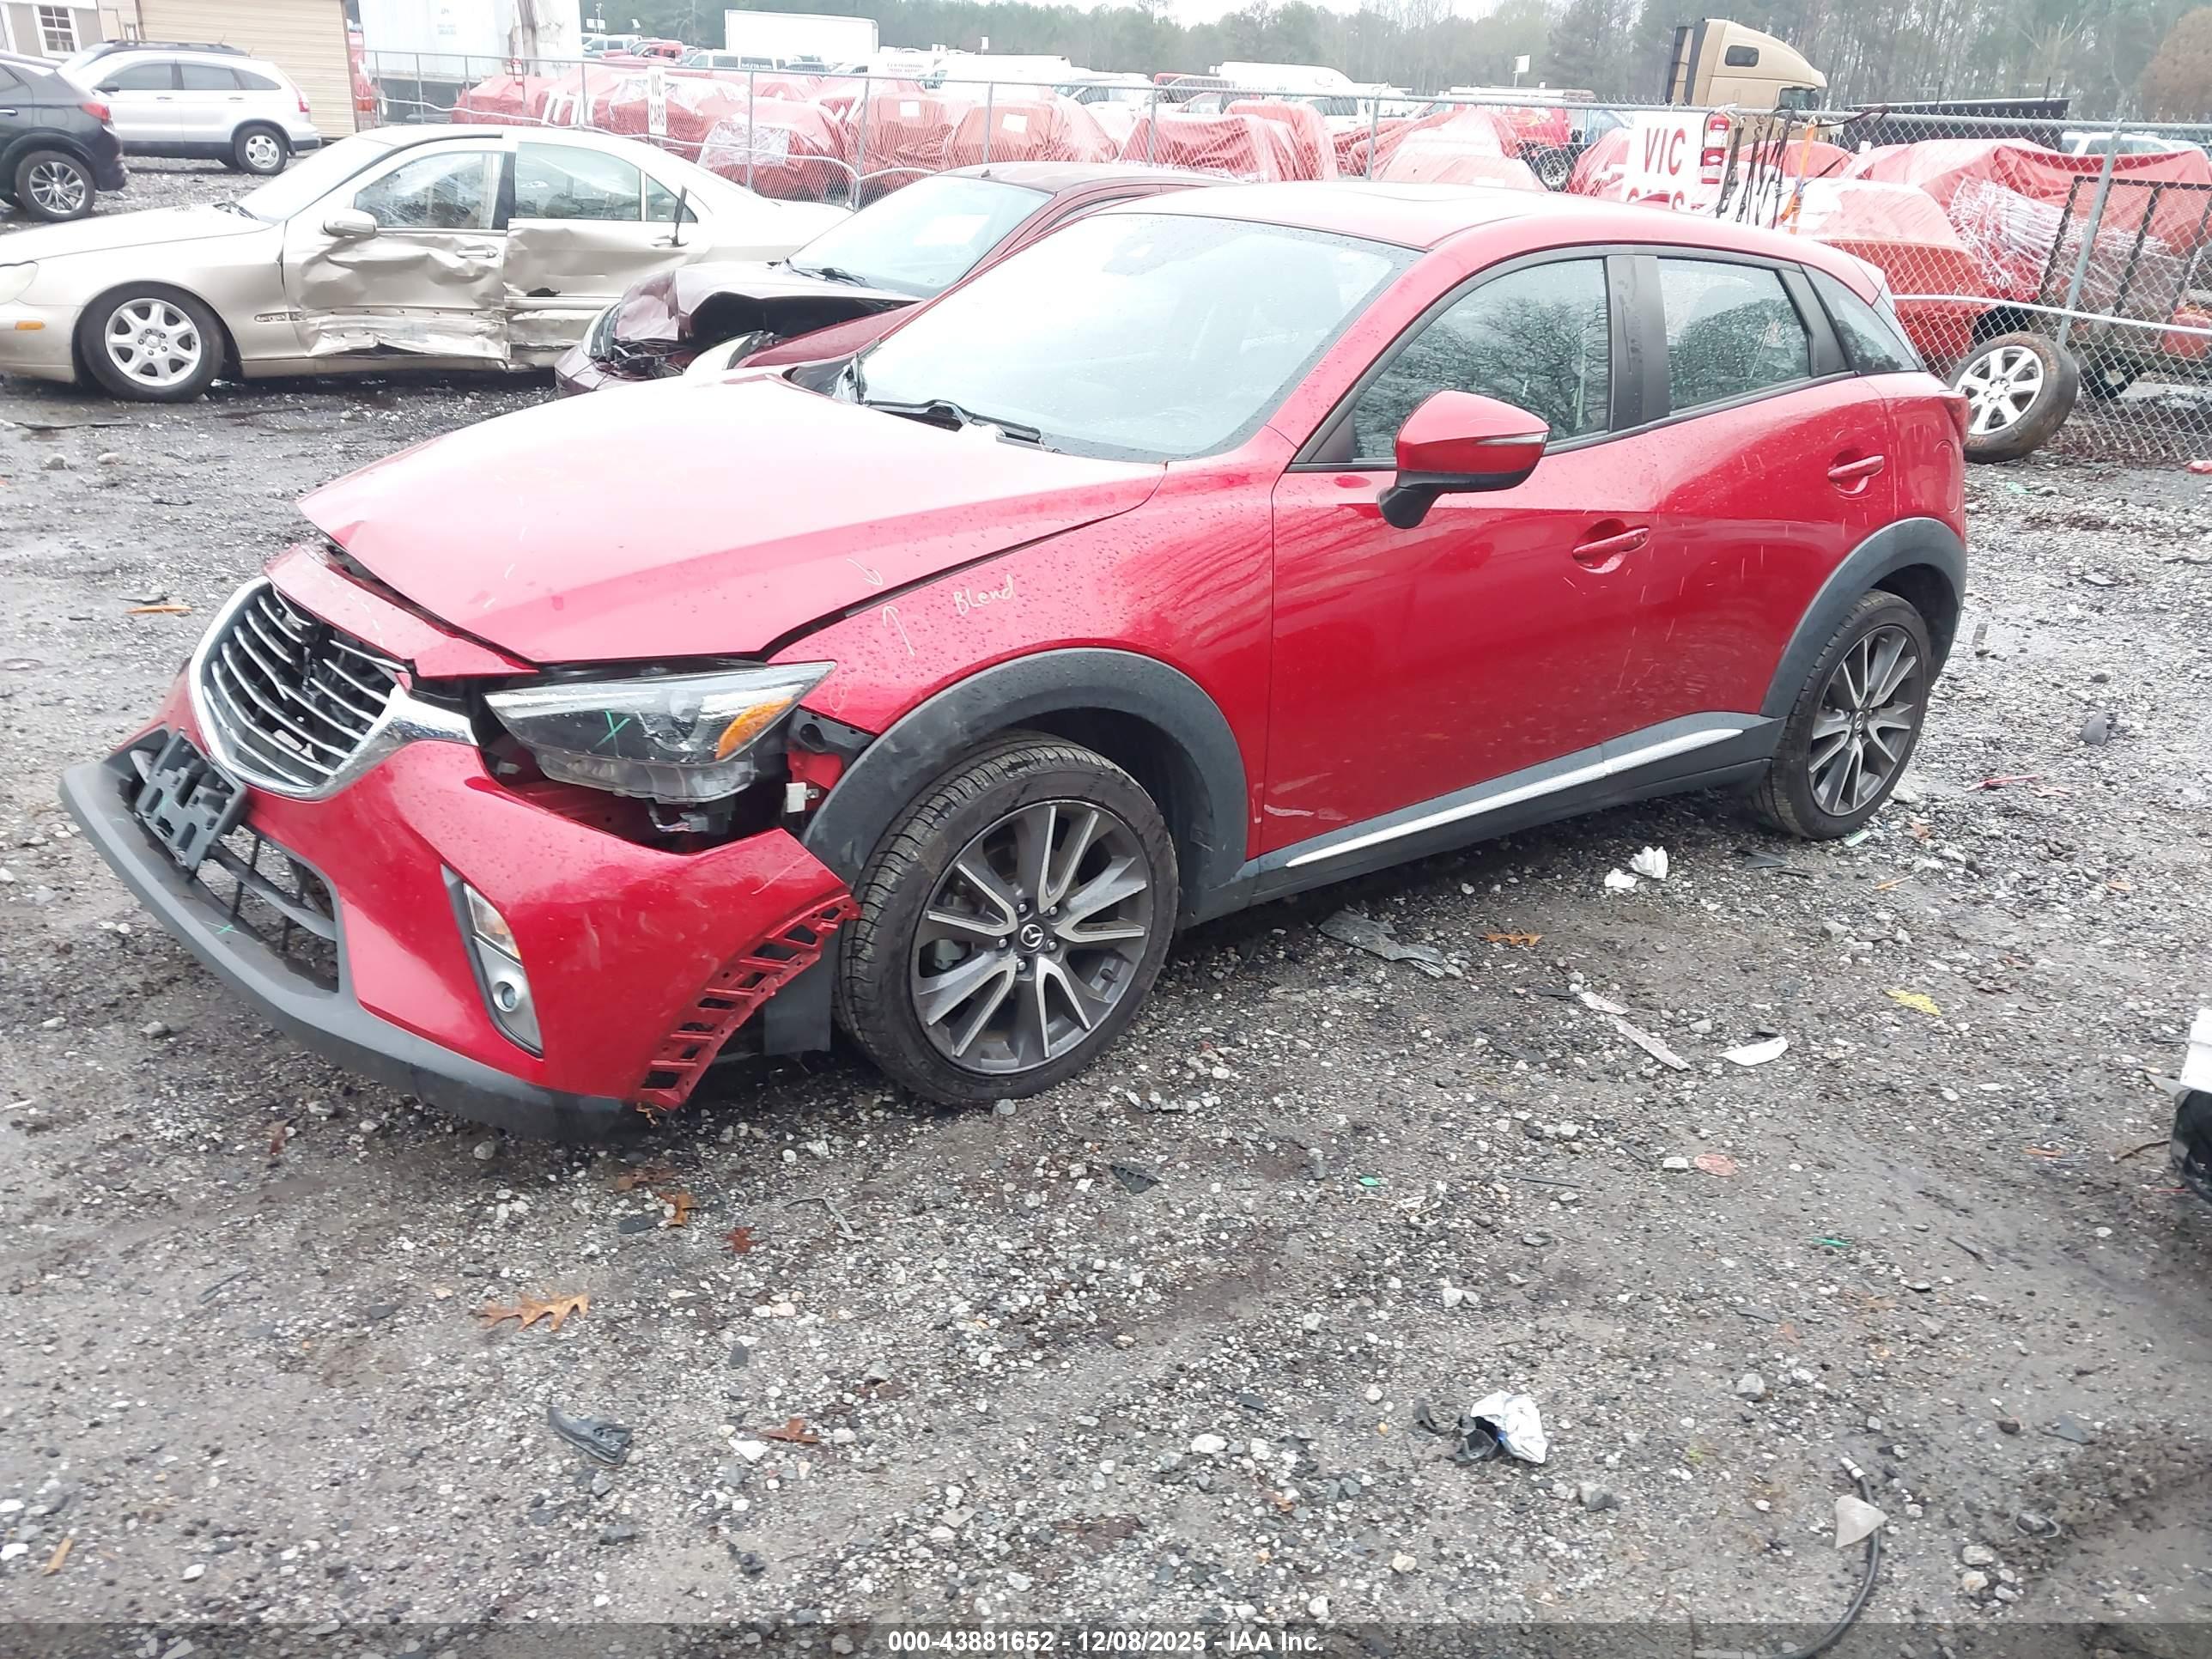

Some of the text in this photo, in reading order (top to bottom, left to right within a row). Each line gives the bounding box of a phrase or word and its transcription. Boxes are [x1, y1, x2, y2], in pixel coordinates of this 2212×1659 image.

[650, 74, 662, 97] VIC
[650, 102, 665, 127] CARS
[1644, 127, 1686, 176] VIC
